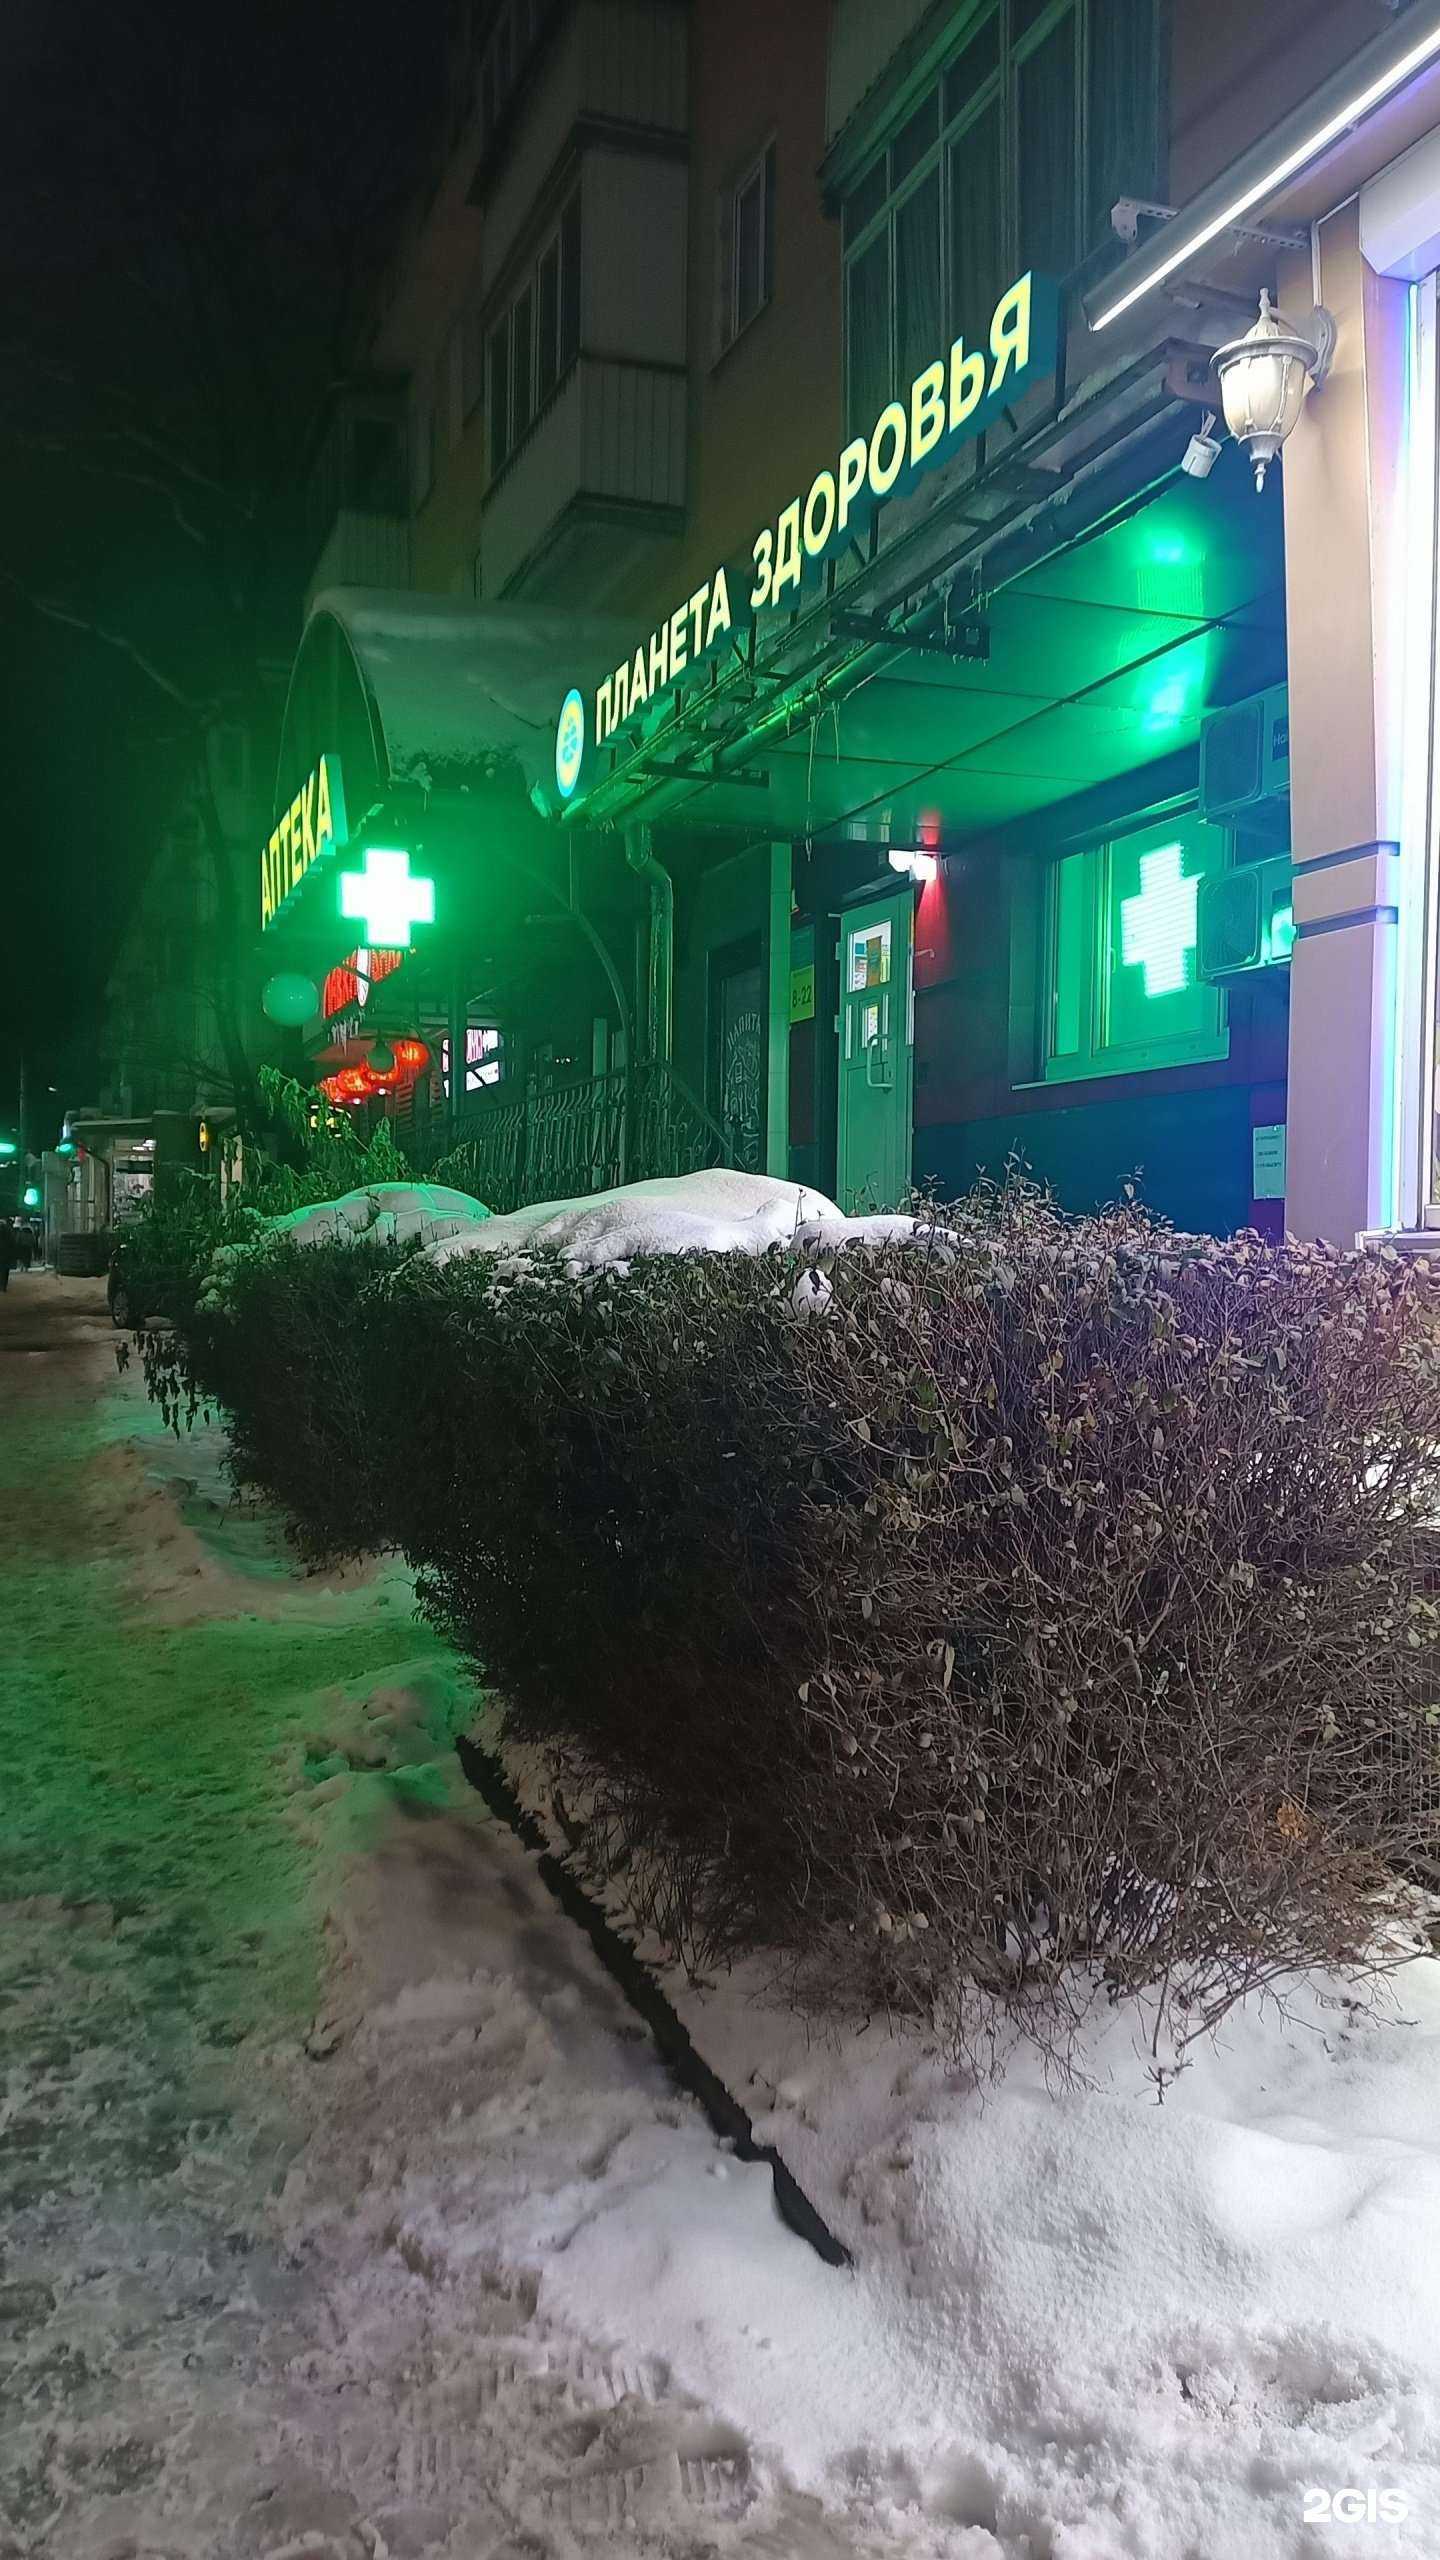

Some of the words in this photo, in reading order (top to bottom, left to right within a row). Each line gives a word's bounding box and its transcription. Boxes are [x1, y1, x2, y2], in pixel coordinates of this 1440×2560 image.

[596, 566, 732, 747] ПЛАНЕТА
[750, 269, 1032, 608] ЗДОРОВЬЯ
[262, 753, 332, 931] АПТЕКА
